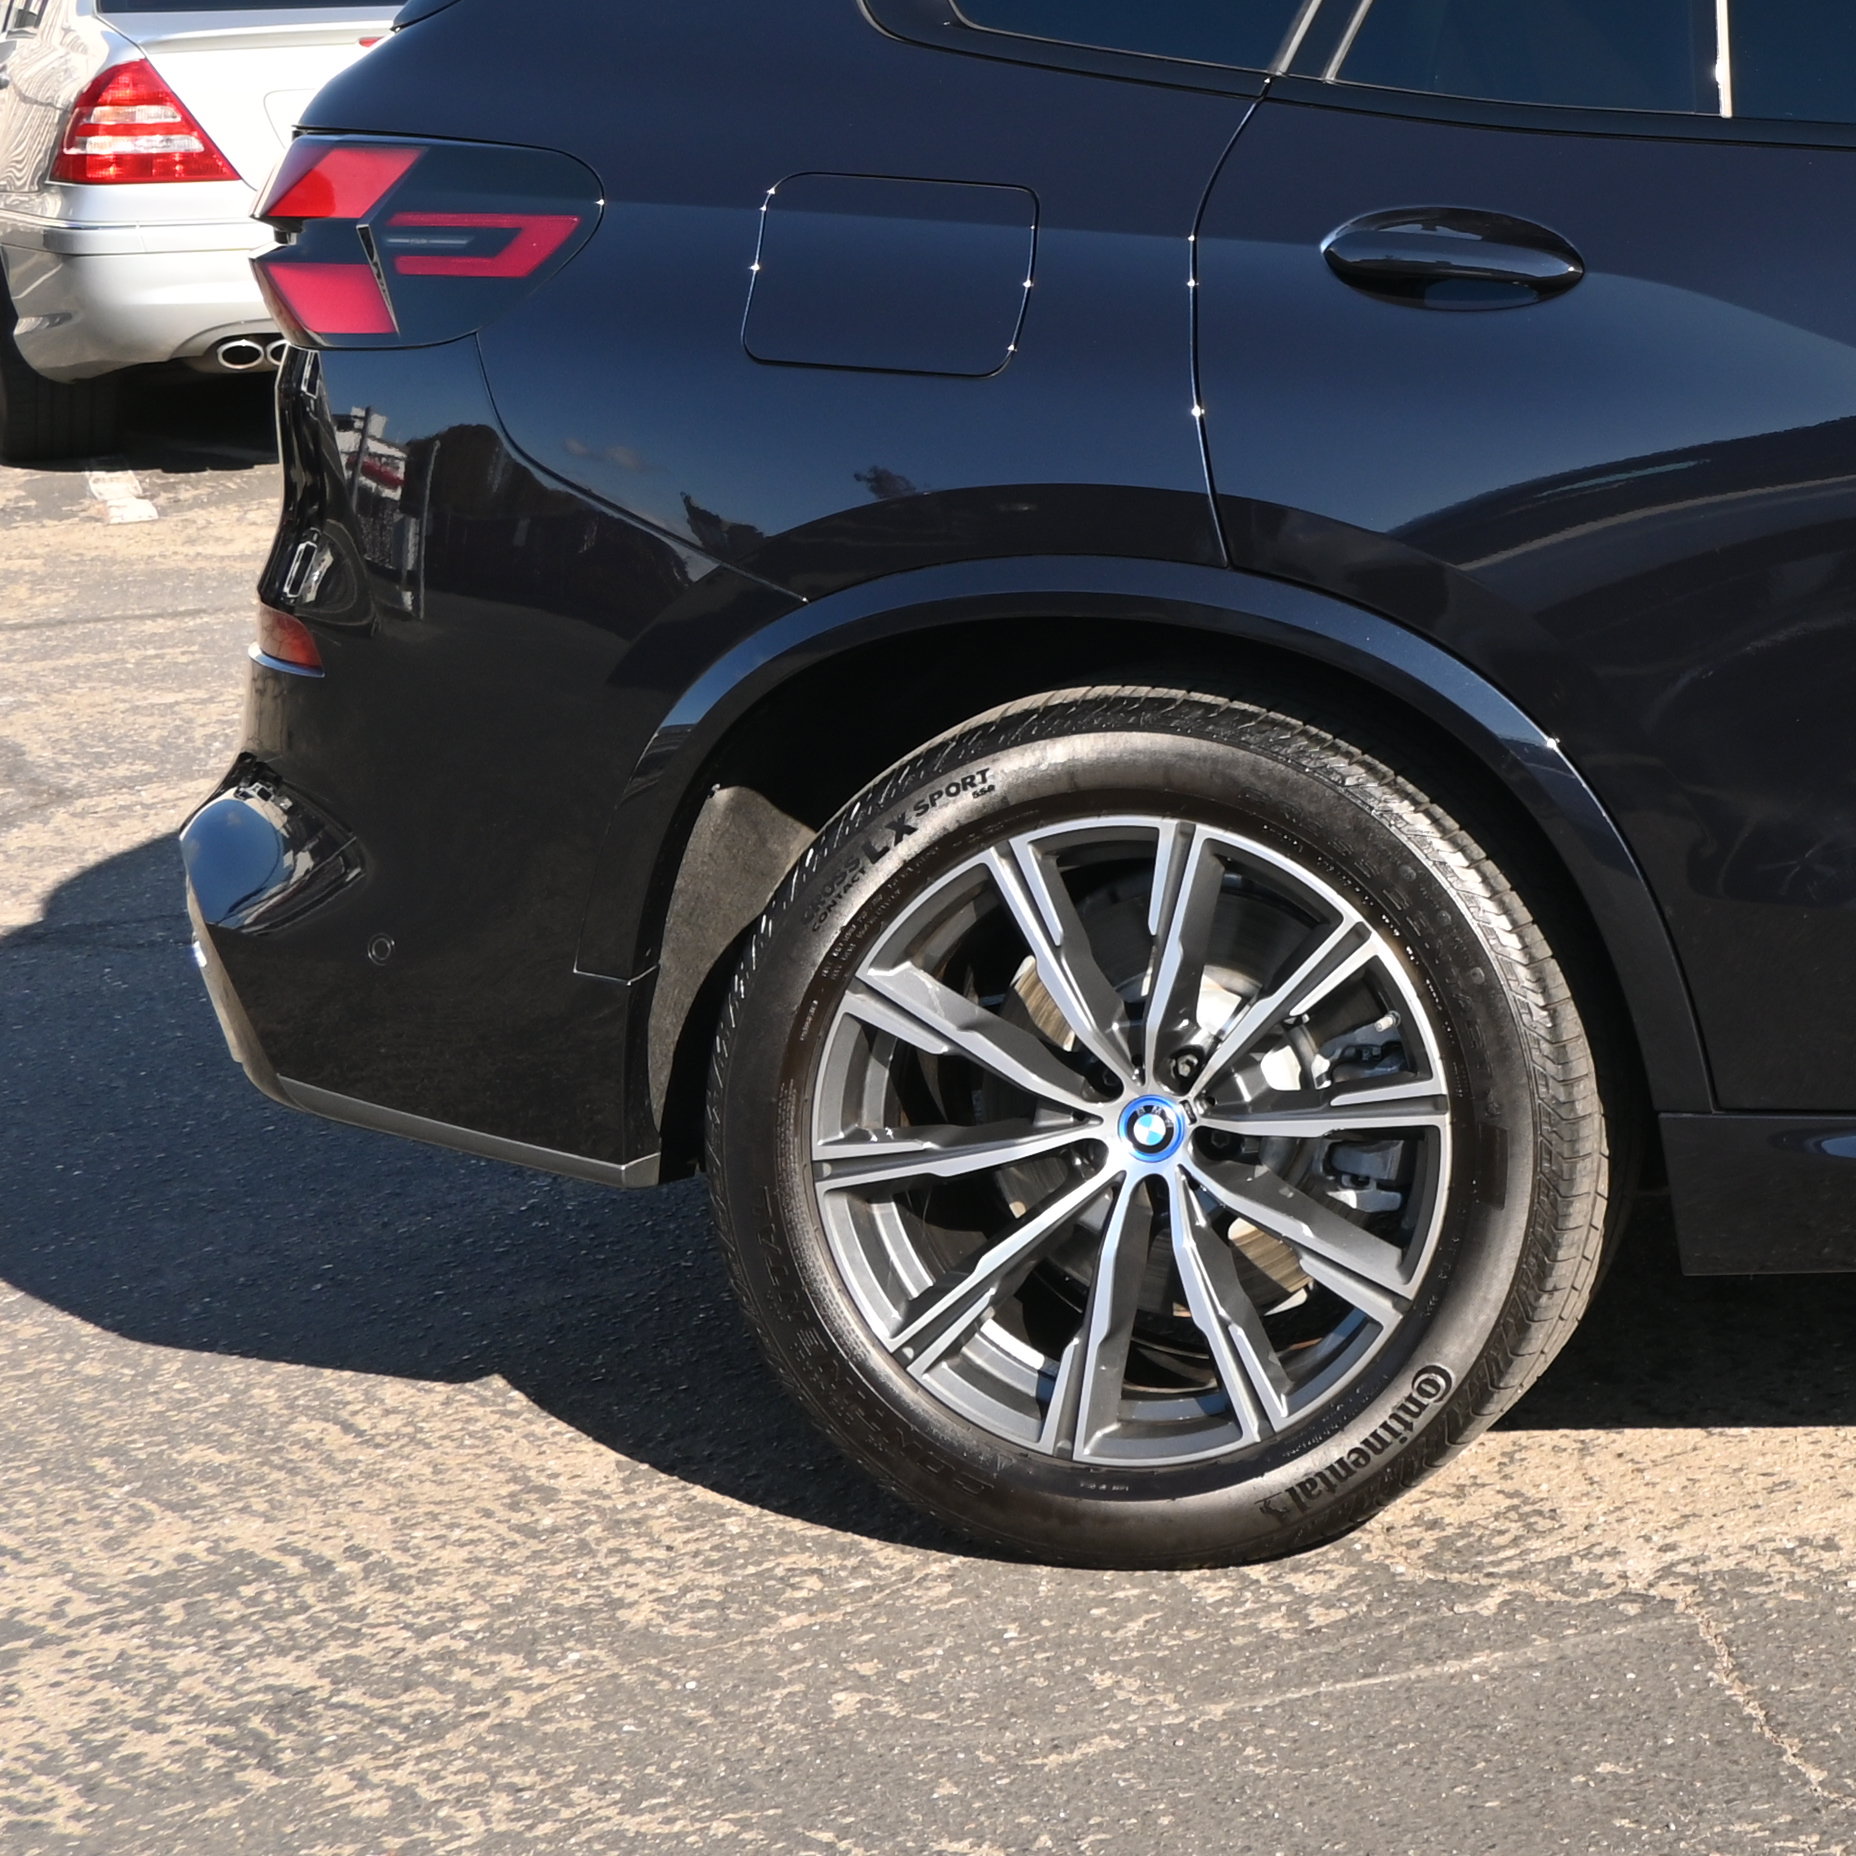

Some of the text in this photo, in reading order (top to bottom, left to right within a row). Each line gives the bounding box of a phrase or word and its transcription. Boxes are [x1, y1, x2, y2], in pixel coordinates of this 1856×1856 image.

[862, 768, 991, 865] LX SPORT
[812, 867, 867, 932] CONTACT
[1285, 1364, 1455, 1514] Continental
